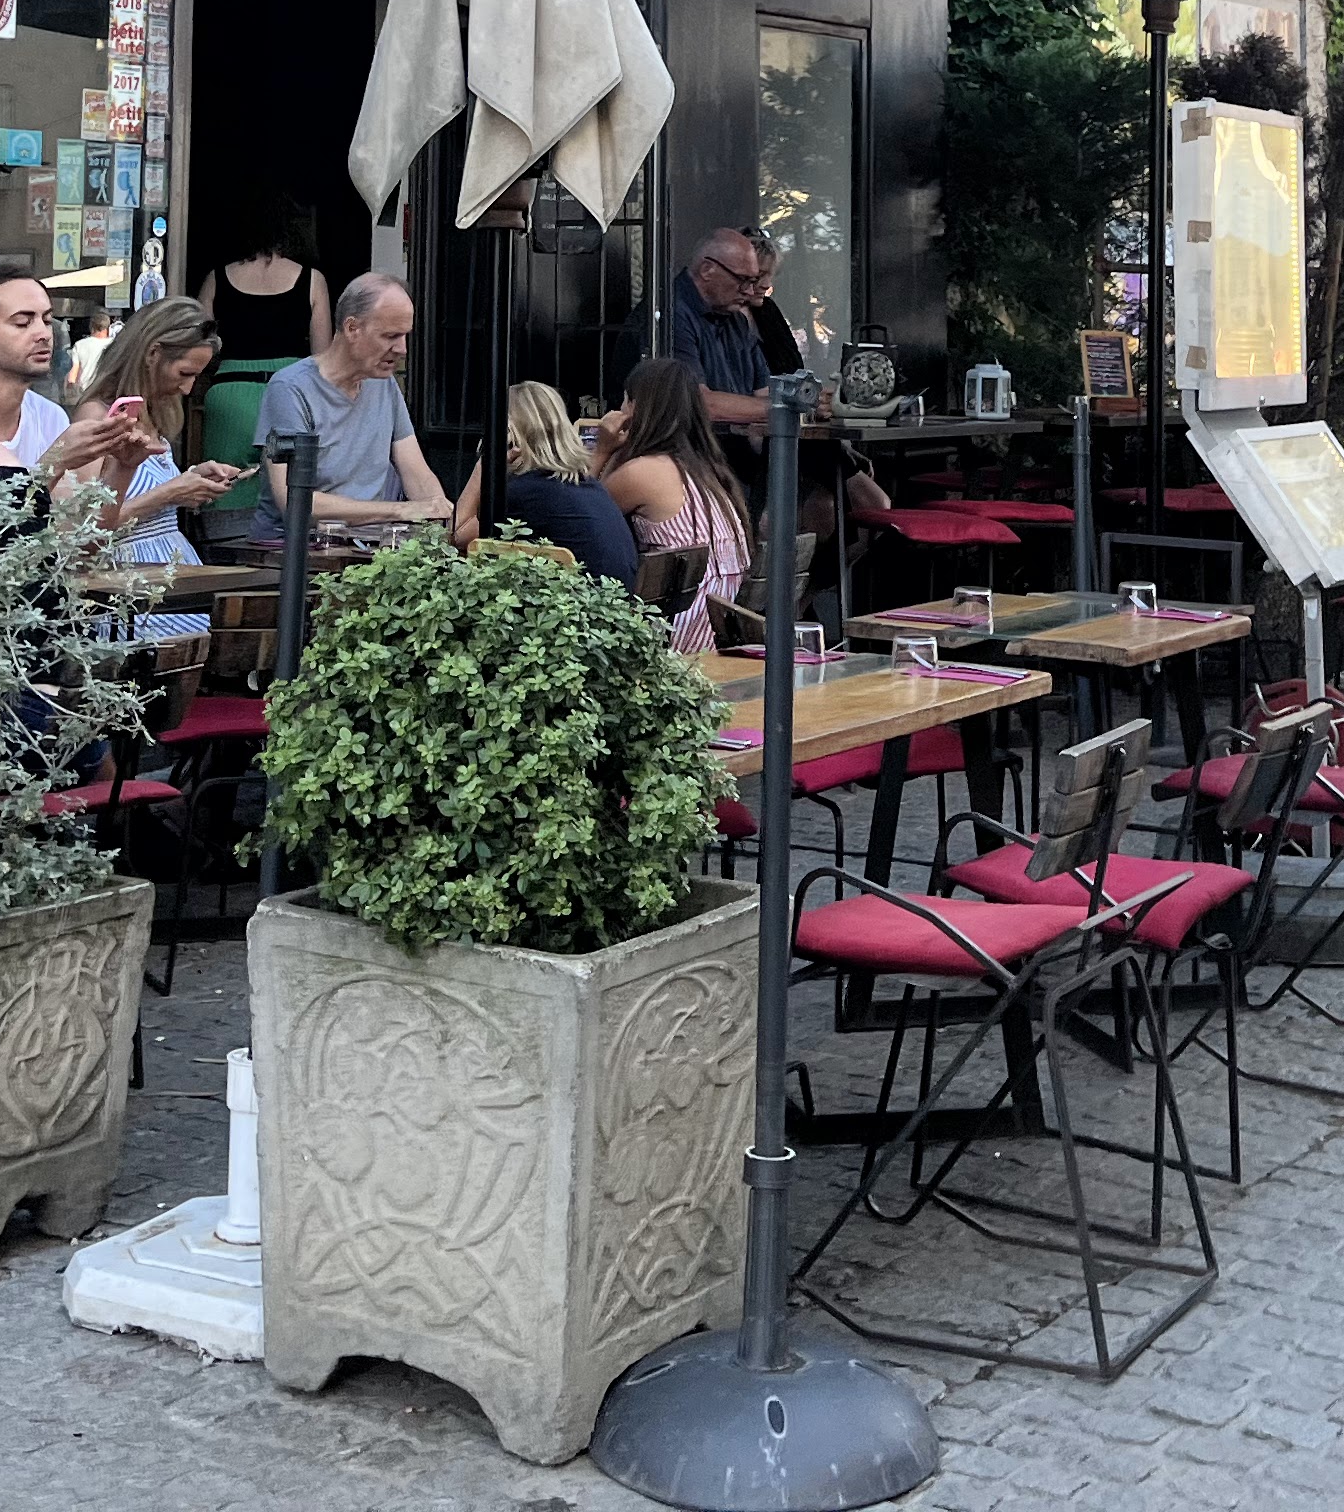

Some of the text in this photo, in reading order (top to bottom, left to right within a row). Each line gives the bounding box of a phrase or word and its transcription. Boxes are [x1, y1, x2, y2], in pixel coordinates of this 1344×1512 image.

[110, 23, 146, 41] petit
[115, 41, 146, 57] futé
[113, 75, 141, 91] 2017
[108, 104, 143, 121] petit
